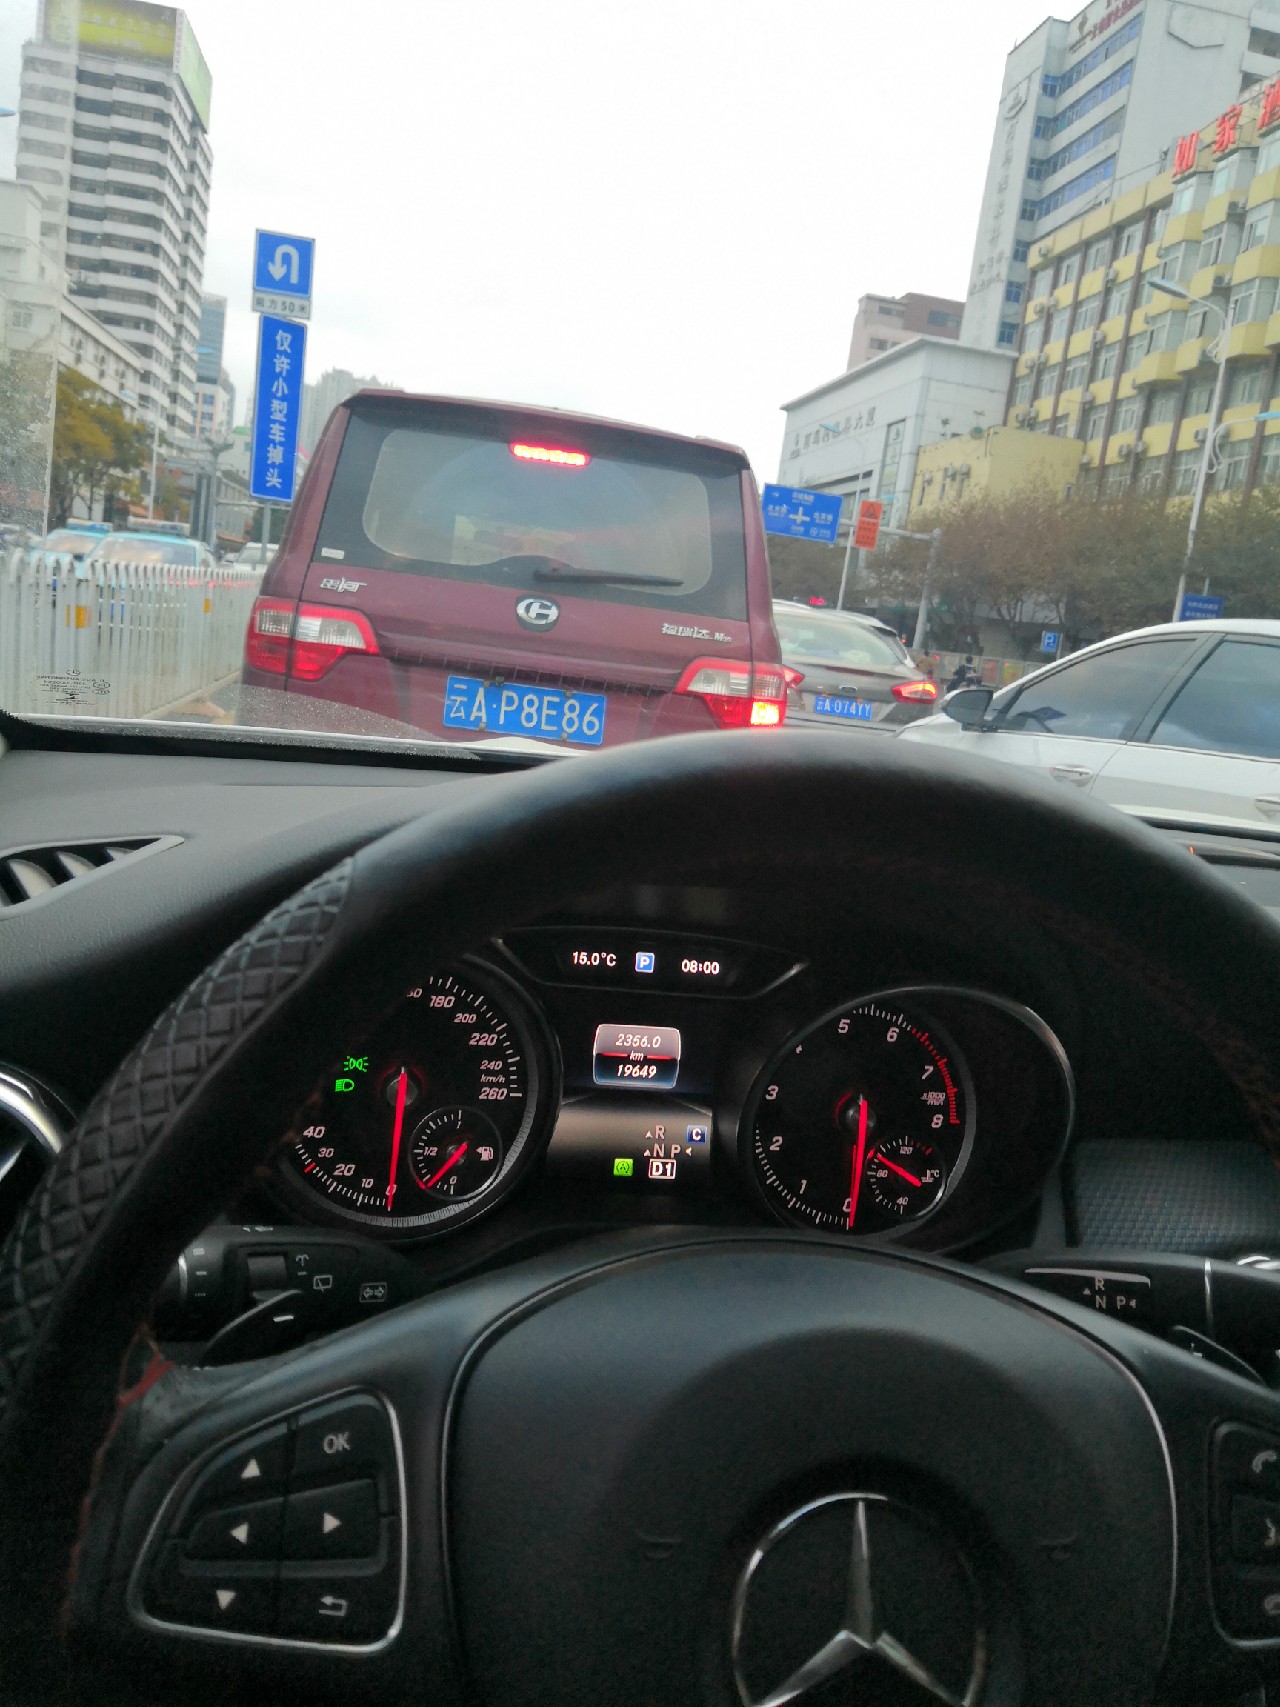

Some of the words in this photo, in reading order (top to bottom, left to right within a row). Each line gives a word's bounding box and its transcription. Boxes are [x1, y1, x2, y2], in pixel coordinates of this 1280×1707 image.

[265, 330, 292, 489] 仅许小型车掉头
[661, 623, 713, 640] 福瑞达
[572, 951, 617, 967] 15.0°C
[681, 959, 720, 975] 08:00
[430, 995, 456, 1008] 180
[453, 1012, 477, 1024] 200
[838, 1018, 851, 1034] 5
[468, 1033, 498, 1046] 220
[615, 1033, 661, 1049] 2356.0
[886, 1026, 899, 1042] 6
[629, 1050, 645, 1062] km
[480, 1060, 502, 1071] 240
[617, 1064, 657, 1079] 19649
[922, 1065, 933, 1080] 7
[480, 1074, 505, 1084] km/h
[479, 1087, 508, 1100] 260
[766, 1085, 779, 1100] 3
[931, 1114, 944, 1128] 8
[303, 1126, 326, 1138] 40
[655, 1124, 665, 1139] R
[691, 1127, 702, 1141] C
[769, 1136, 783, 1151] 2
[318, 1147, 334, 1158] 30
[653, 1143, 665, 1158] N
[671, 1144, 681, 1159] P
[333, 1163, 356, 1177] 20
[361, 1178, 374, 1189] 10
[450, 1175, 457, 1185] 0
[799, 1179, 807, 1194] 1
[896, 1197, 909, 1206] 40
[1095, 1277, 1106, 1291] R
[1095, 1295, 1107, 1309] N
[1117, 1296, 1127, 1309] P
[323, 1431, 351, 1454] OK
